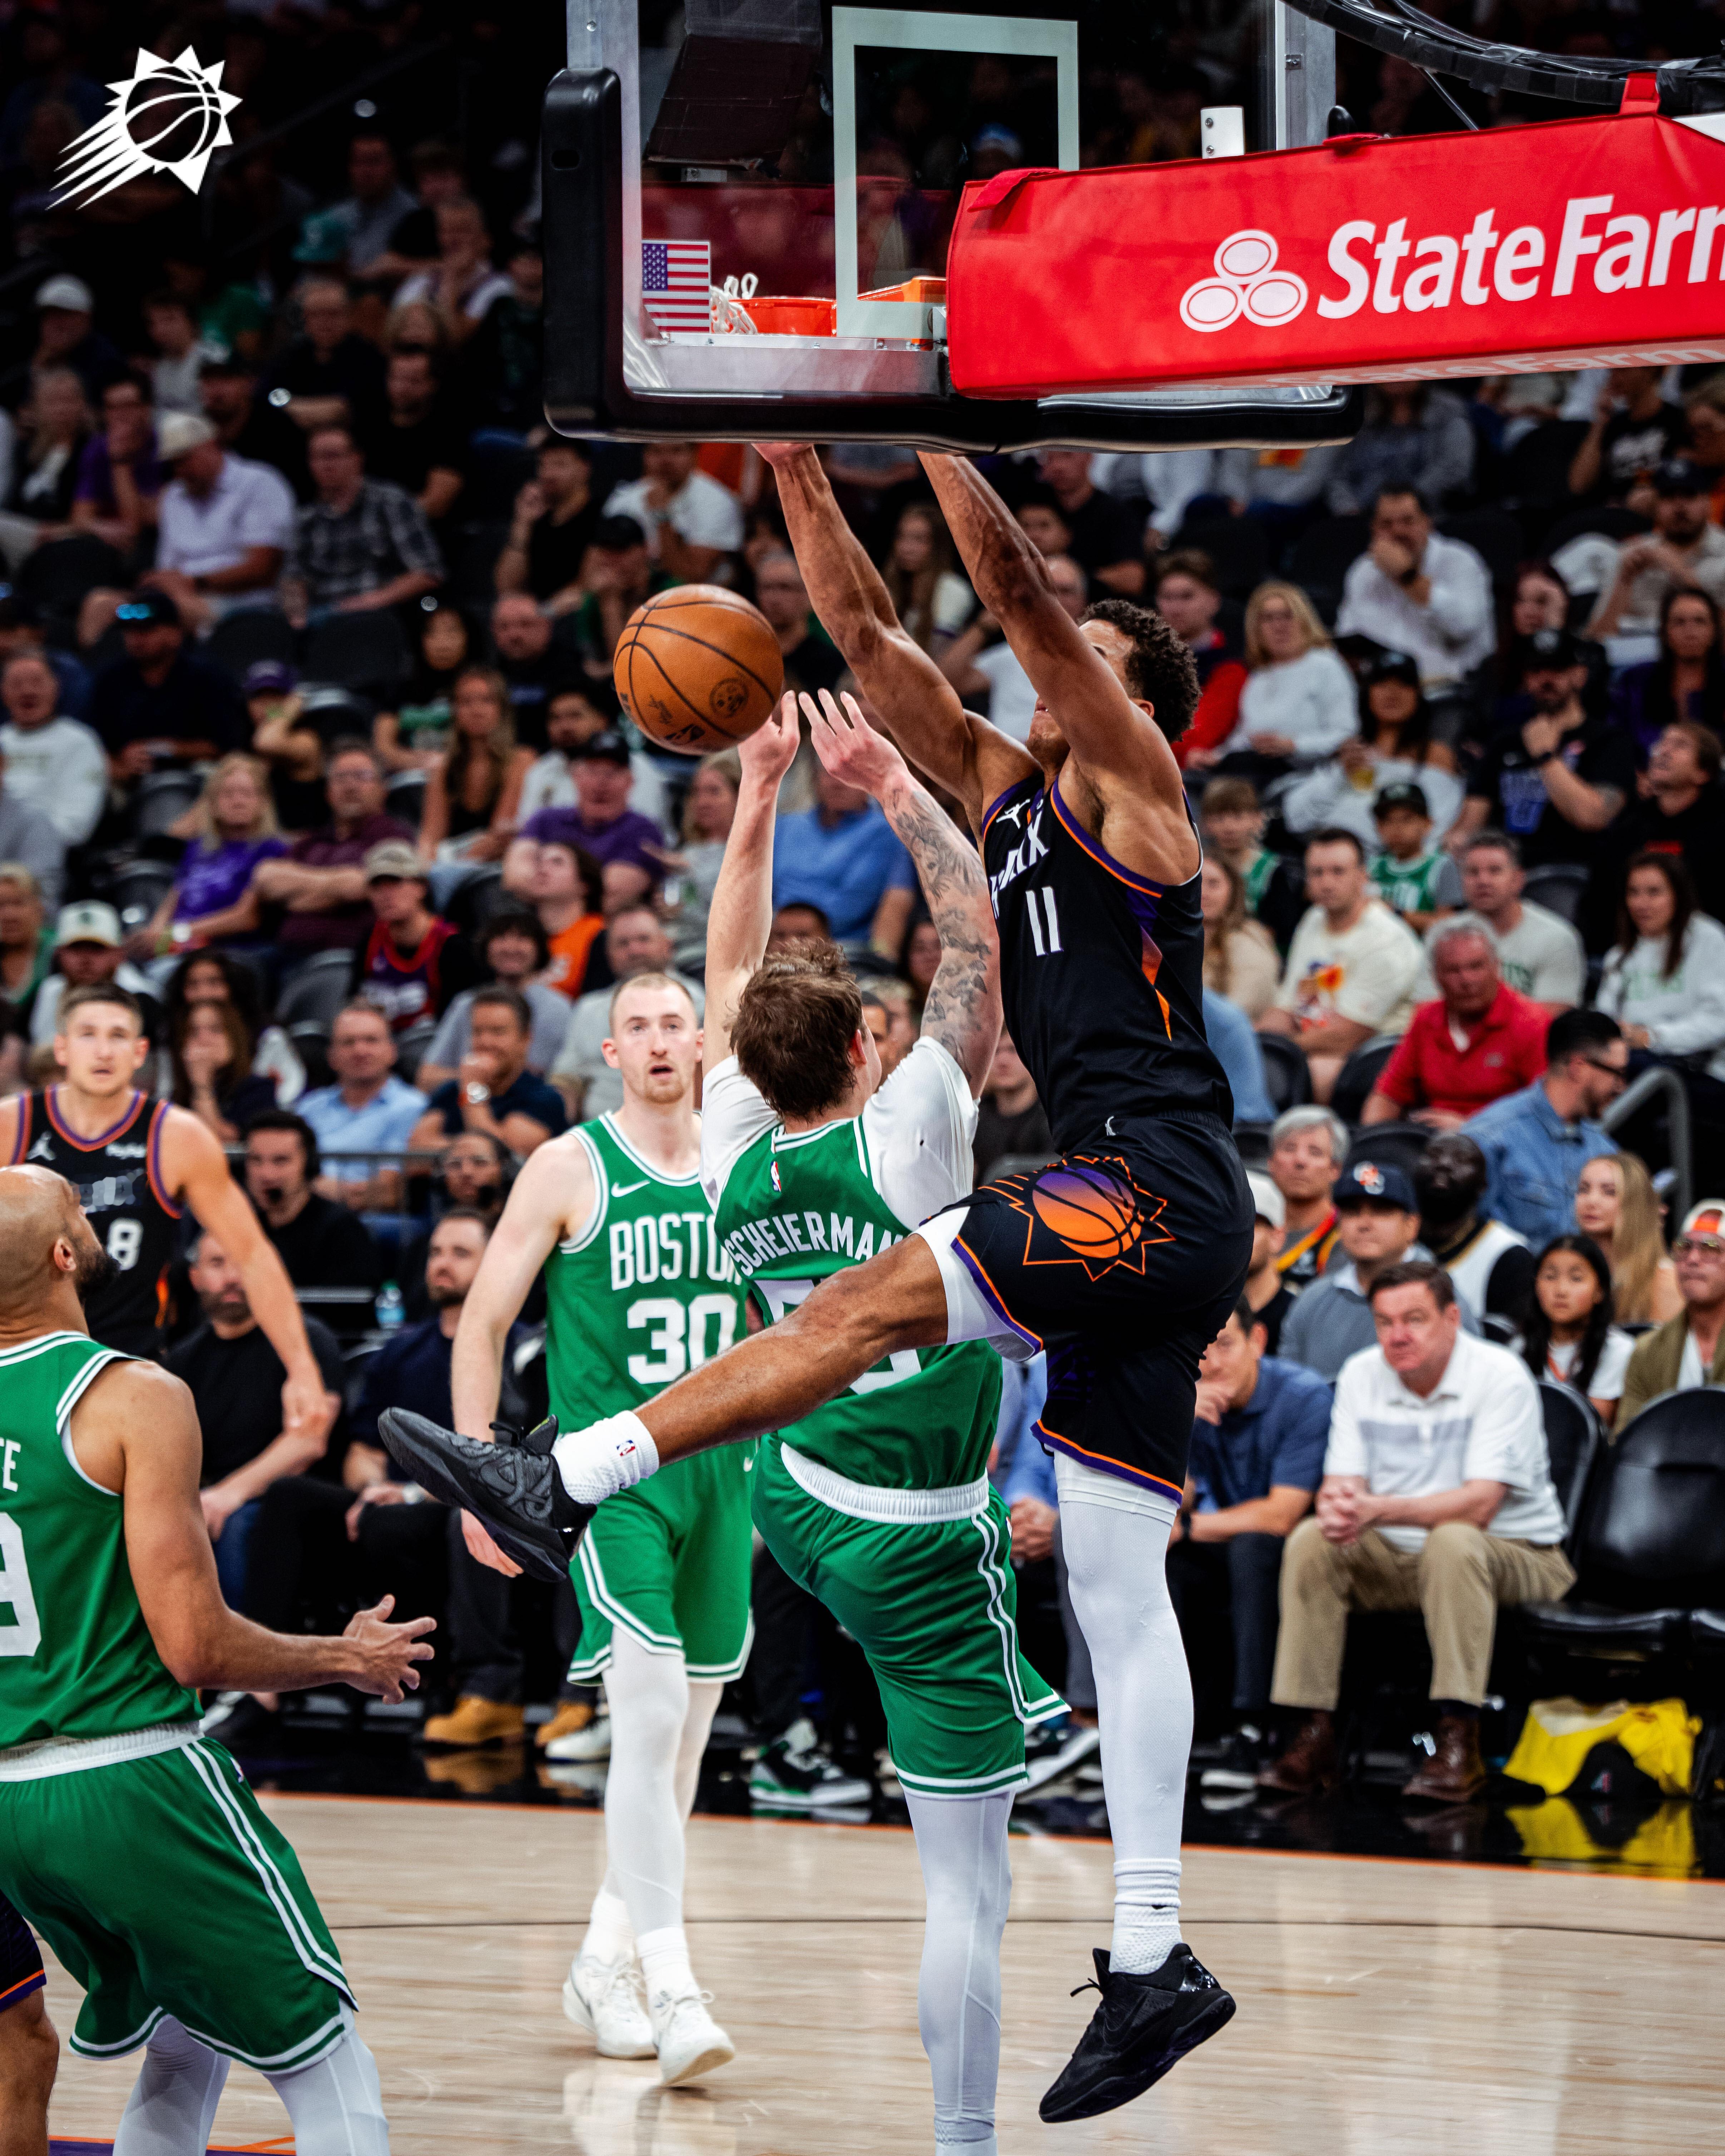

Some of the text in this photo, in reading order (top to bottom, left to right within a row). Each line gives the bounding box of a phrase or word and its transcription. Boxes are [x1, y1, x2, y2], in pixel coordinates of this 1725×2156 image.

[1025, 886, 1063, 956] 11
[107, 1218, 143, 1270] 8
[627, 1293, 738, 1385] 30
